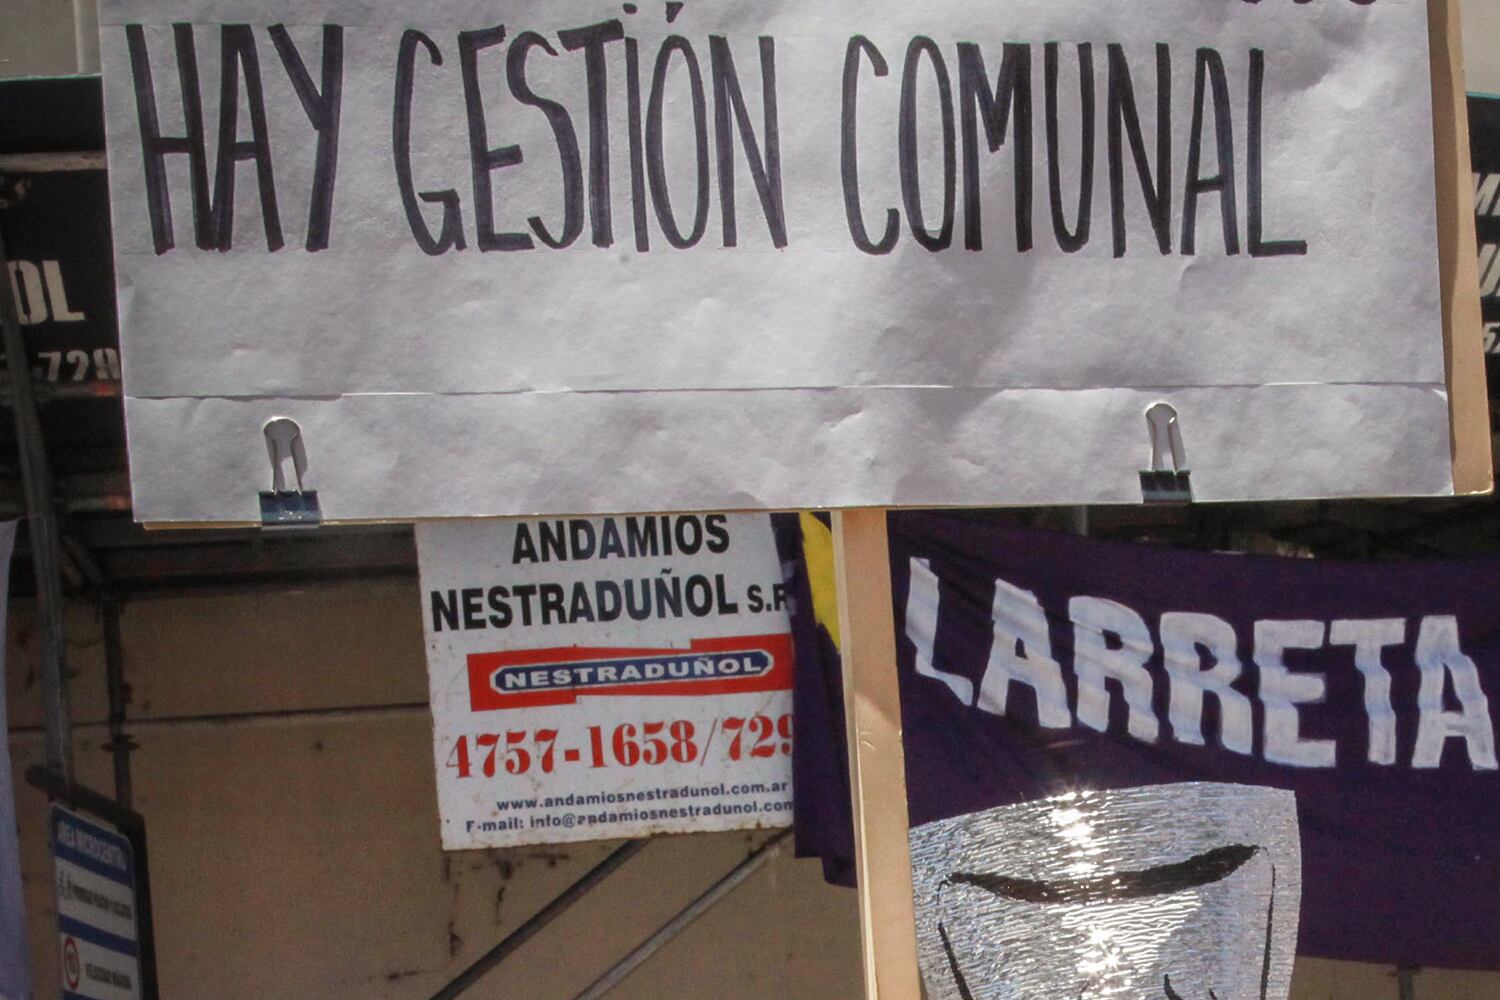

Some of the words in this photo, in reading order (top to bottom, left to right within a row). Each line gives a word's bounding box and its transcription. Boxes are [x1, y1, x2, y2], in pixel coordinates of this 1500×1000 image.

[125, 23, 343, 256] HAY
[392, 1, 788, 257] GESTIÓN
[840, 34, 1307, 259] COMUNAL
[512, 514, 730, 564] ANDAMIOS
[430, 567, 738, 632] NESTRADUÑOL
[504, 655, 762, 689] NESTRADUÑOL
[904, 556, 1498, 771] LARRETA
[496, 780, 788, 811] www.andamiosnestradunol.com.ar
